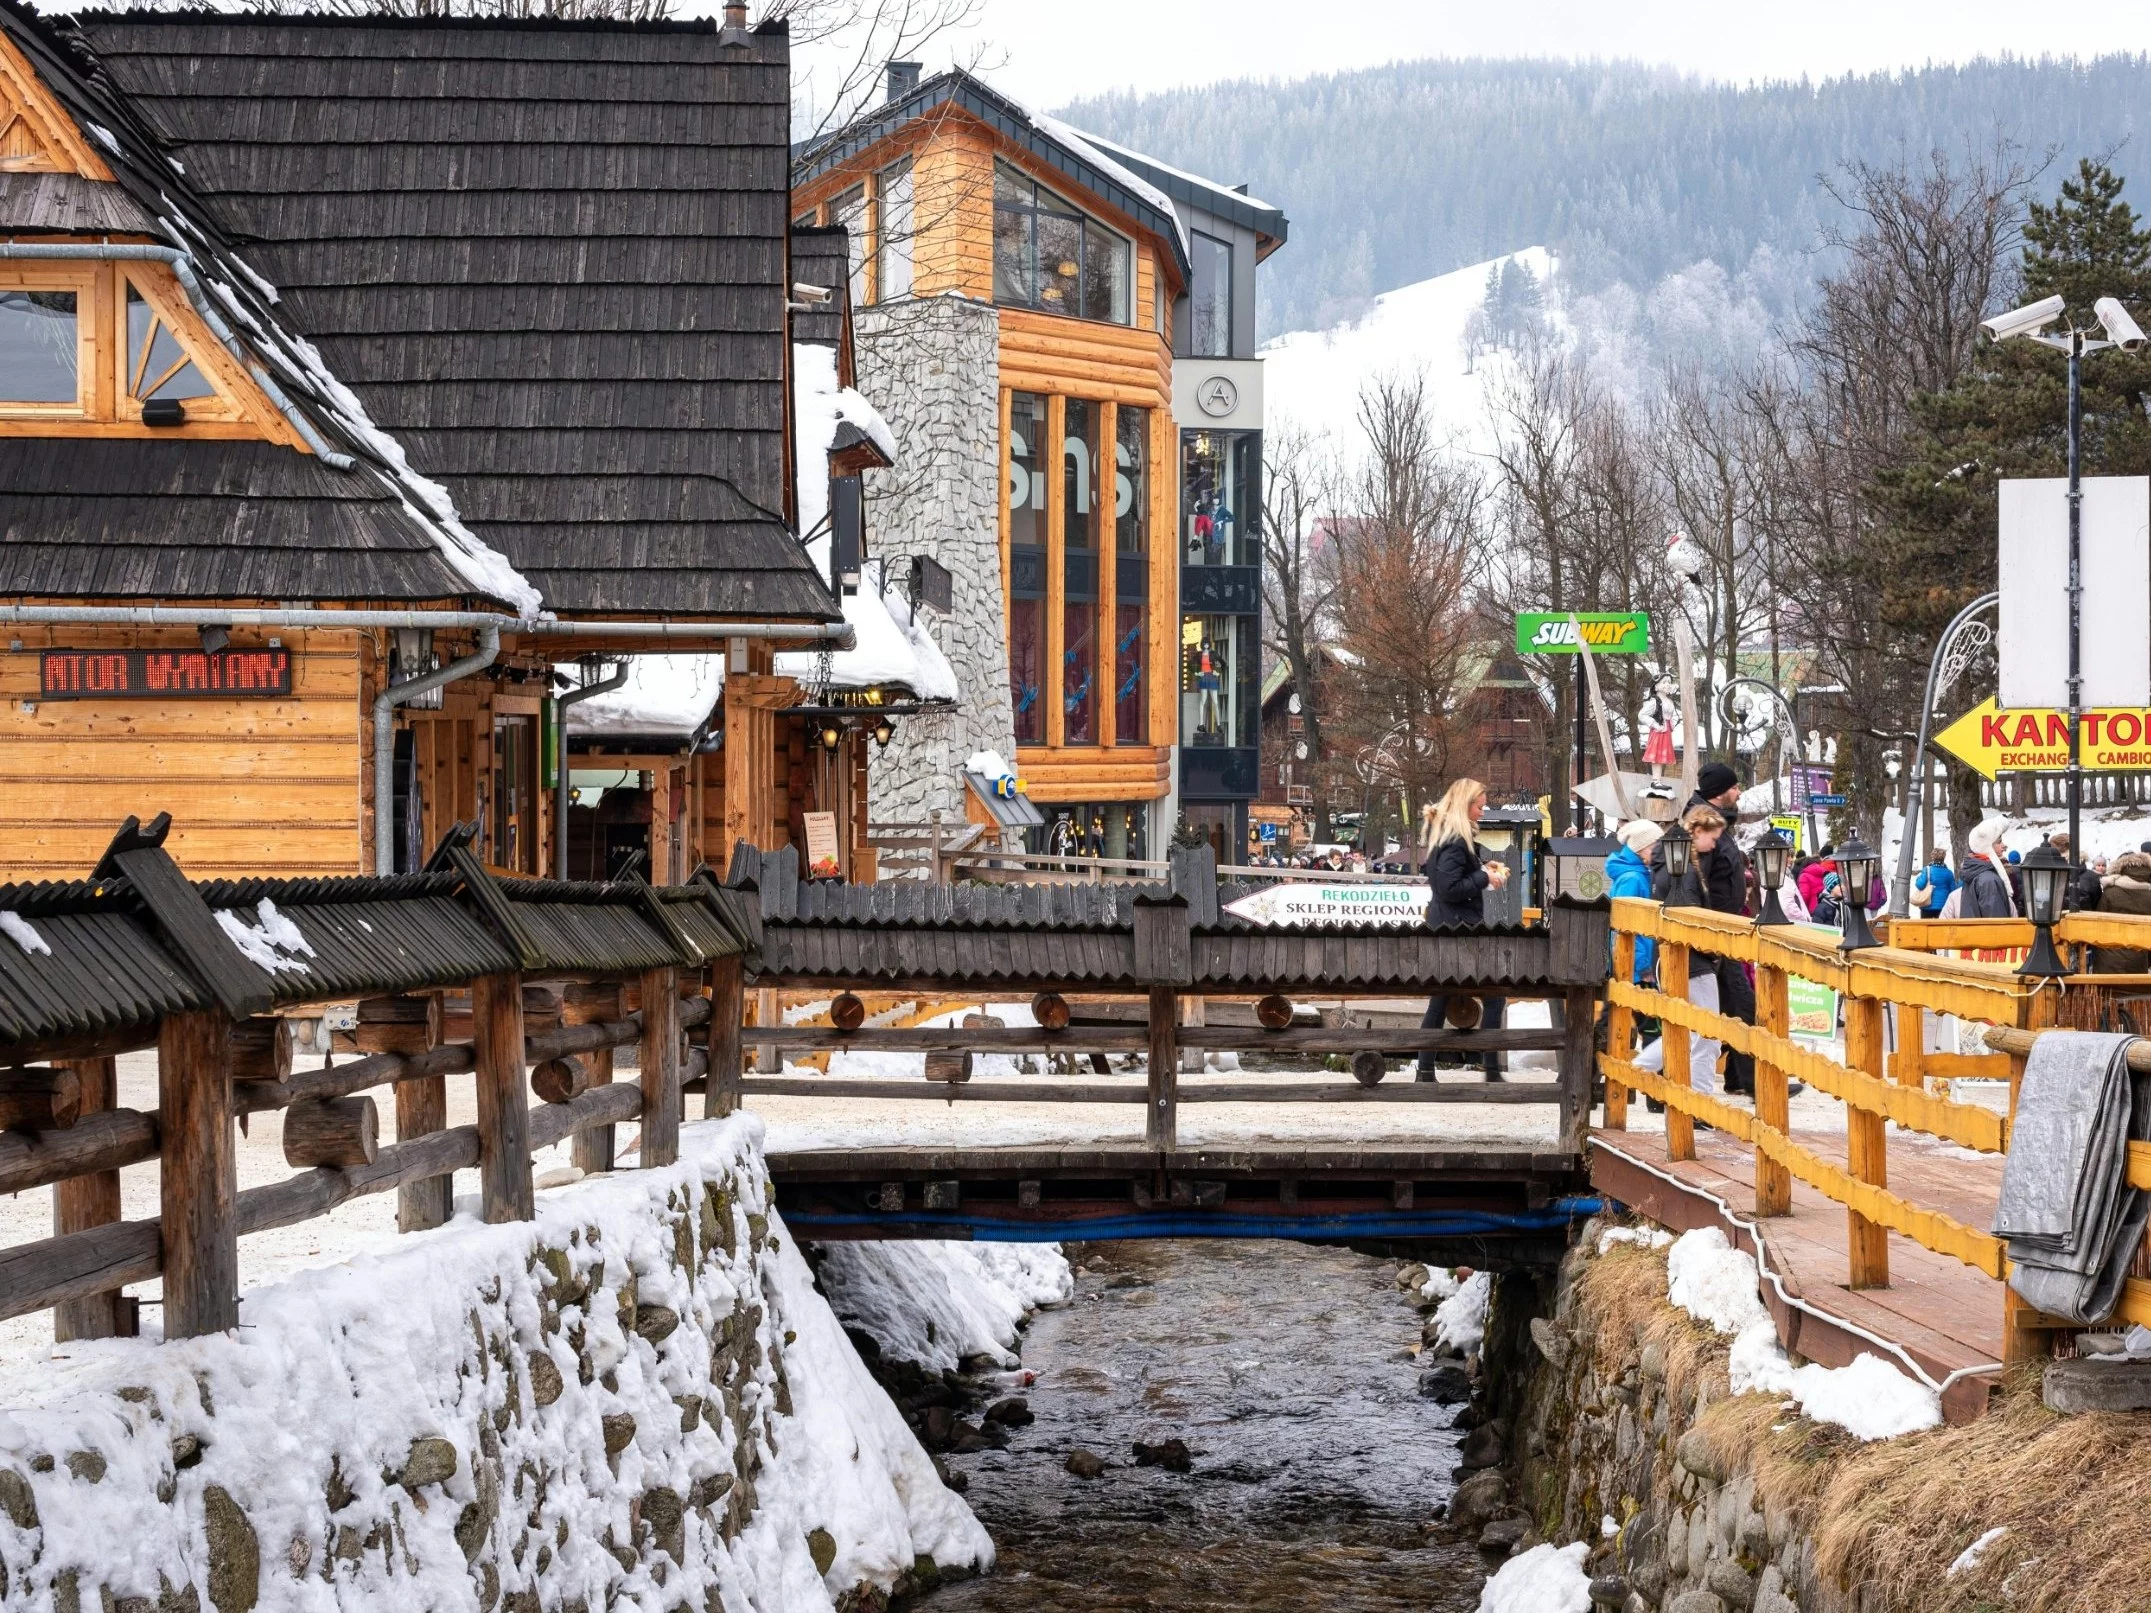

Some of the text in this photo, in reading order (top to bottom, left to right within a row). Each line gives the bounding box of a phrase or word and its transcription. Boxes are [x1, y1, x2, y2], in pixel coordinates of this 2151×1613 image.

[1530, 619, 1638, 647] SUBWAY
[1982, 713, 2151, 748] KANTO
[2001, 752, 2151, 766] EXCHANG CAMBIO
[1286, 903, 1426, 916] SKLEP REGIONAL
